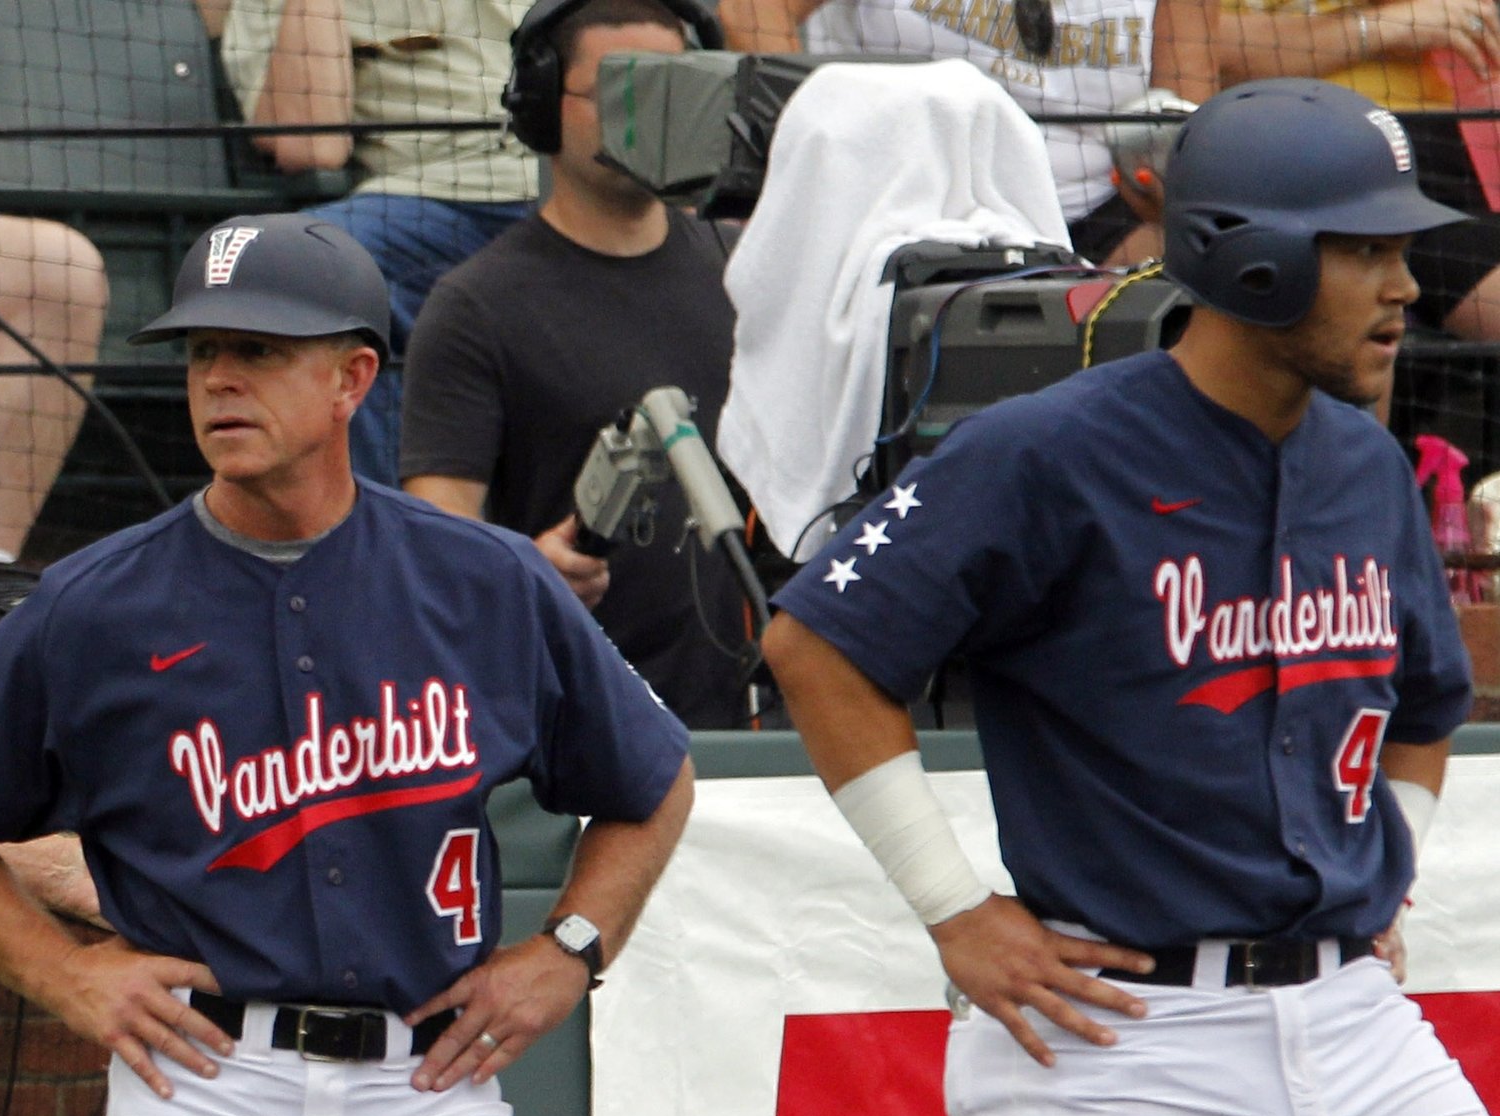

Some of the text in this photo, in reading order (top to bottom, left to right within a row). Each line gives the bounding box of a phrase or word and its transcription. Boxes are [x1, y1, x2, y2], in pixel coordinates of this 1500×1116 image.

[206, 226, 262, 287] V
[1155, 553, 1398, 668] Vanderbilt
[168, 677, 478, 834] Vanderbilt
[1332, 708, 1391, 824] 4
[426, 828, 482, 946] 4
